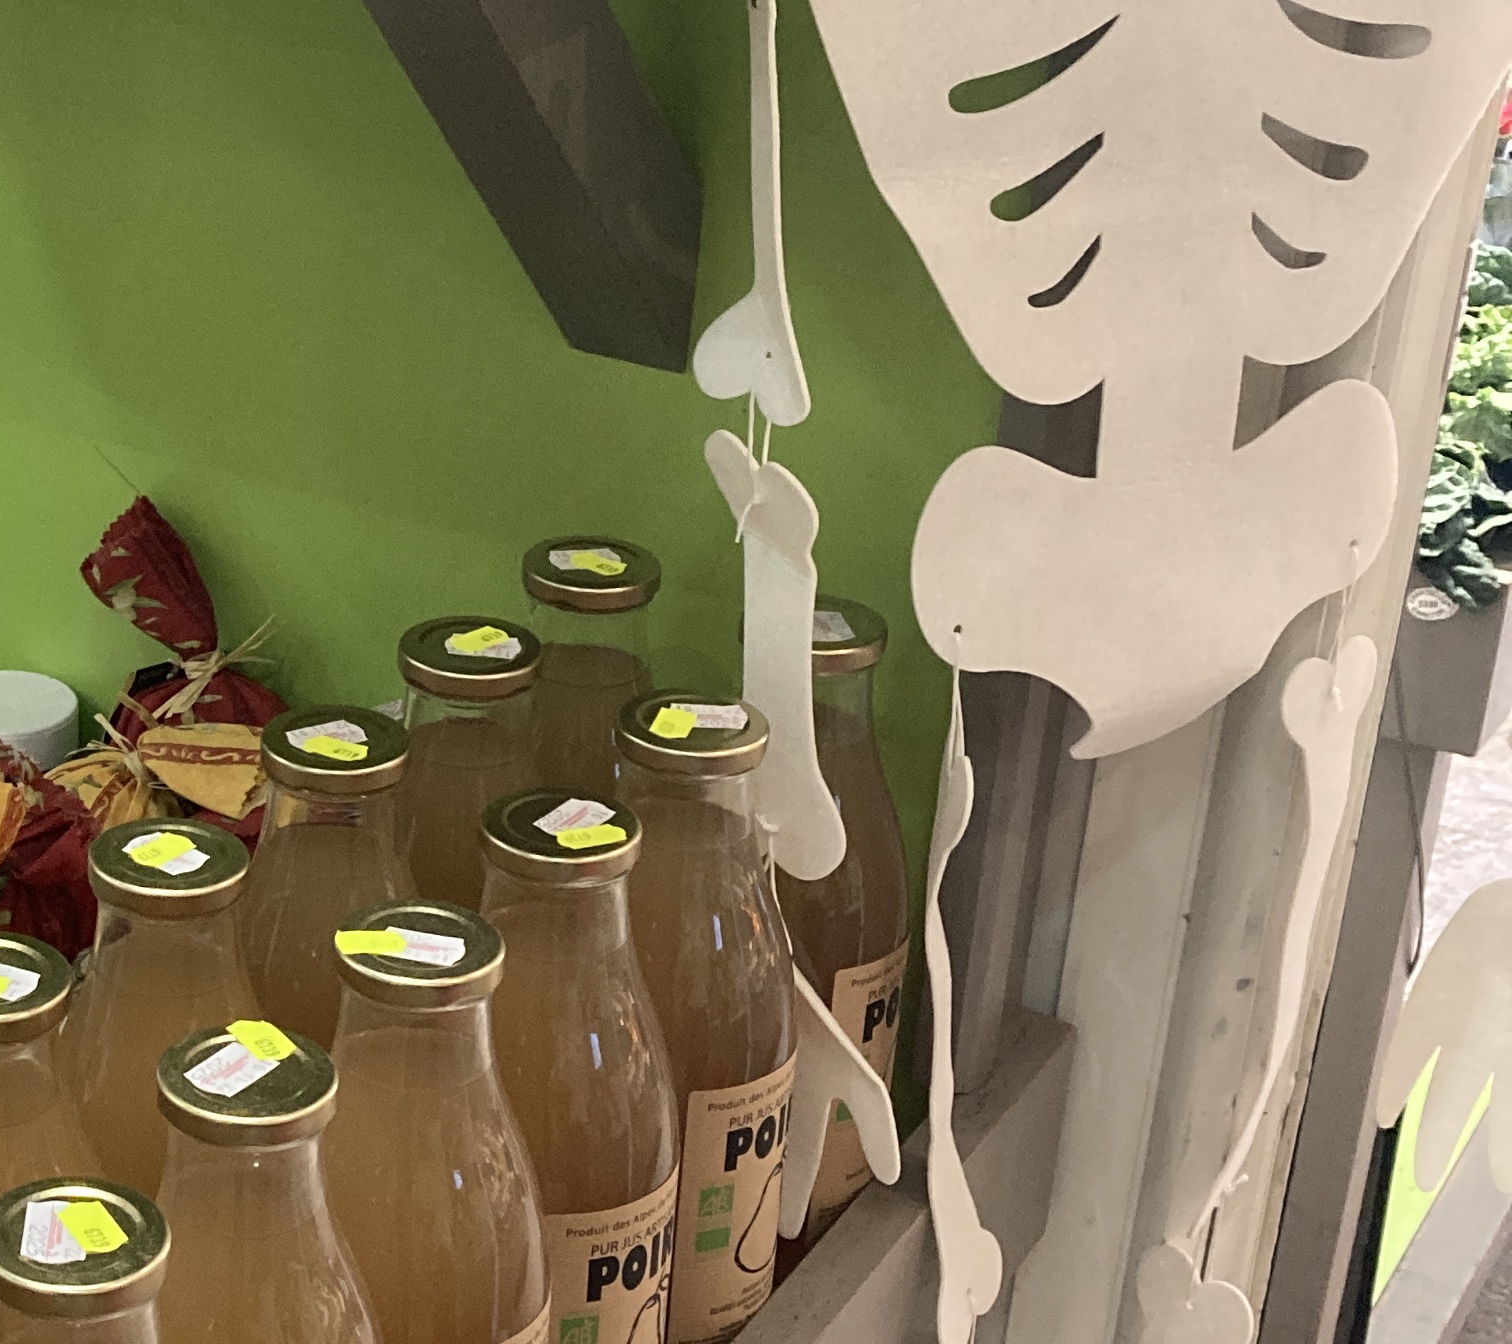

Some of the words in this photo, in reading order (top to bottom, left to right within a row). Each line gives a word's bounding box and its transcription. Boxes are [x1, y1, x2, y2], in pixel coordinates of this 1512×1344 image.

[706, 1097, 747, 1114] Produit
[729, 1112, 754, 1129] PUR
[565, 1224, 607, 1239] Produit
[607, 1217, 631, 1234] des
[590, 1239, 619, 1256] PUR
[620, 1232, 643, 1251] JUS
